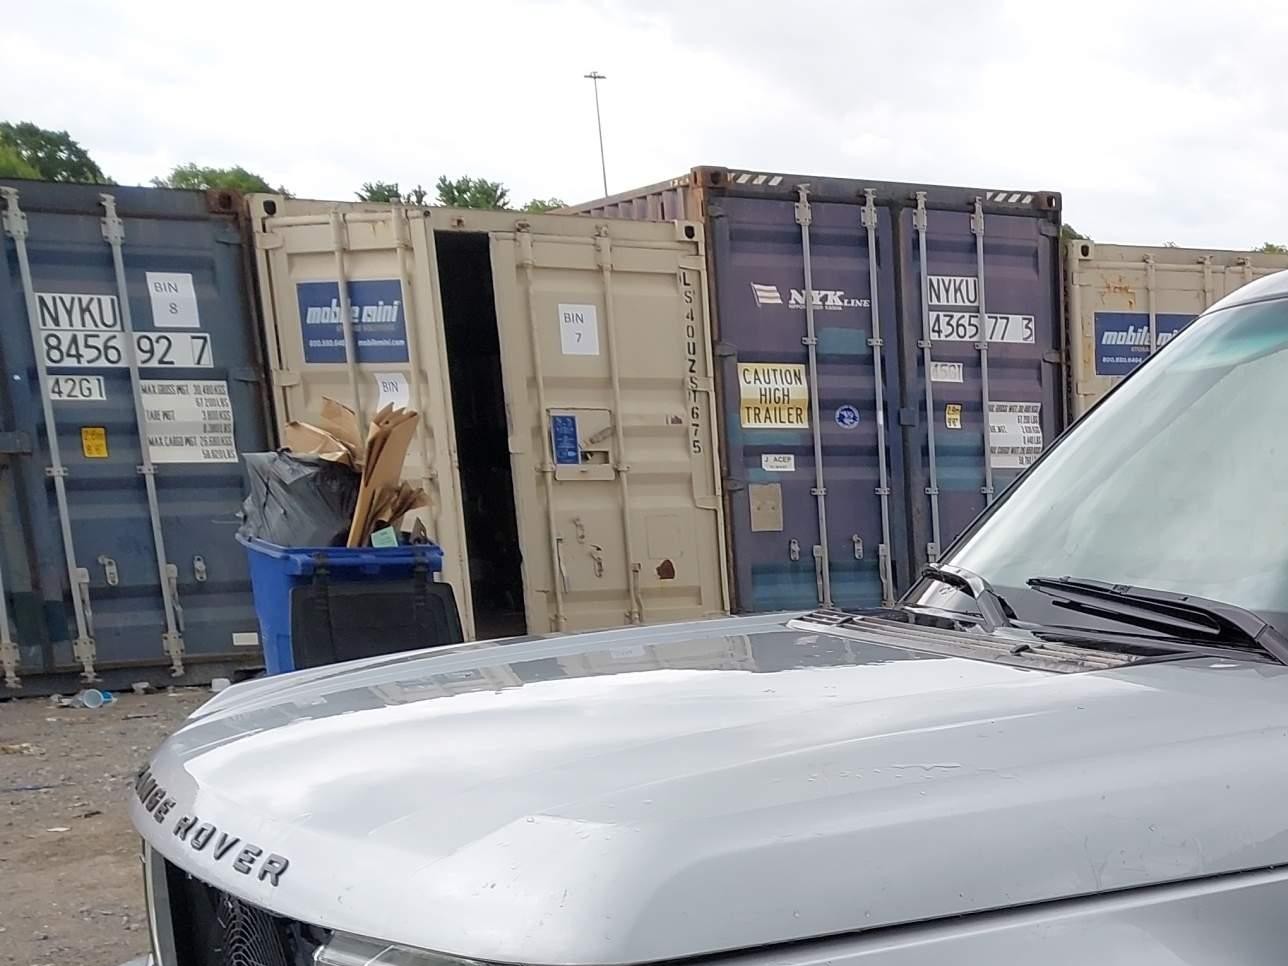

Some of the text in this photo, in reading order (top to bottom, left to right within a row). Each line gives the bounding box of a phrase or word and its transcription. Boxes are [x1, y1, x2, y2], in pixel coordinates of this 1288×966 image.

[154, 282, 179, 293] BIN
[928, 278, 978, 304] NYKU
[789, 289, 844, 305] NYK
[843, 299, 871, 307] LINE
[37, 295, 119, 328] NYKU
[563, 312, 584, 323] BIN
[576, 333, 582, 343] 7
[1021, 317, 1033, 341] 3
[190, 335, 208, 365] 7
[742, 368, 803, 386] CAUTION
[51, 377, 104, 398] 42G1
[381, 381, 399, 393] BIN
[759, 387, 791, 404] HIGH
[745, 405, 804, 425] TRAILER
[172, 815, 289, 887] ROVER
